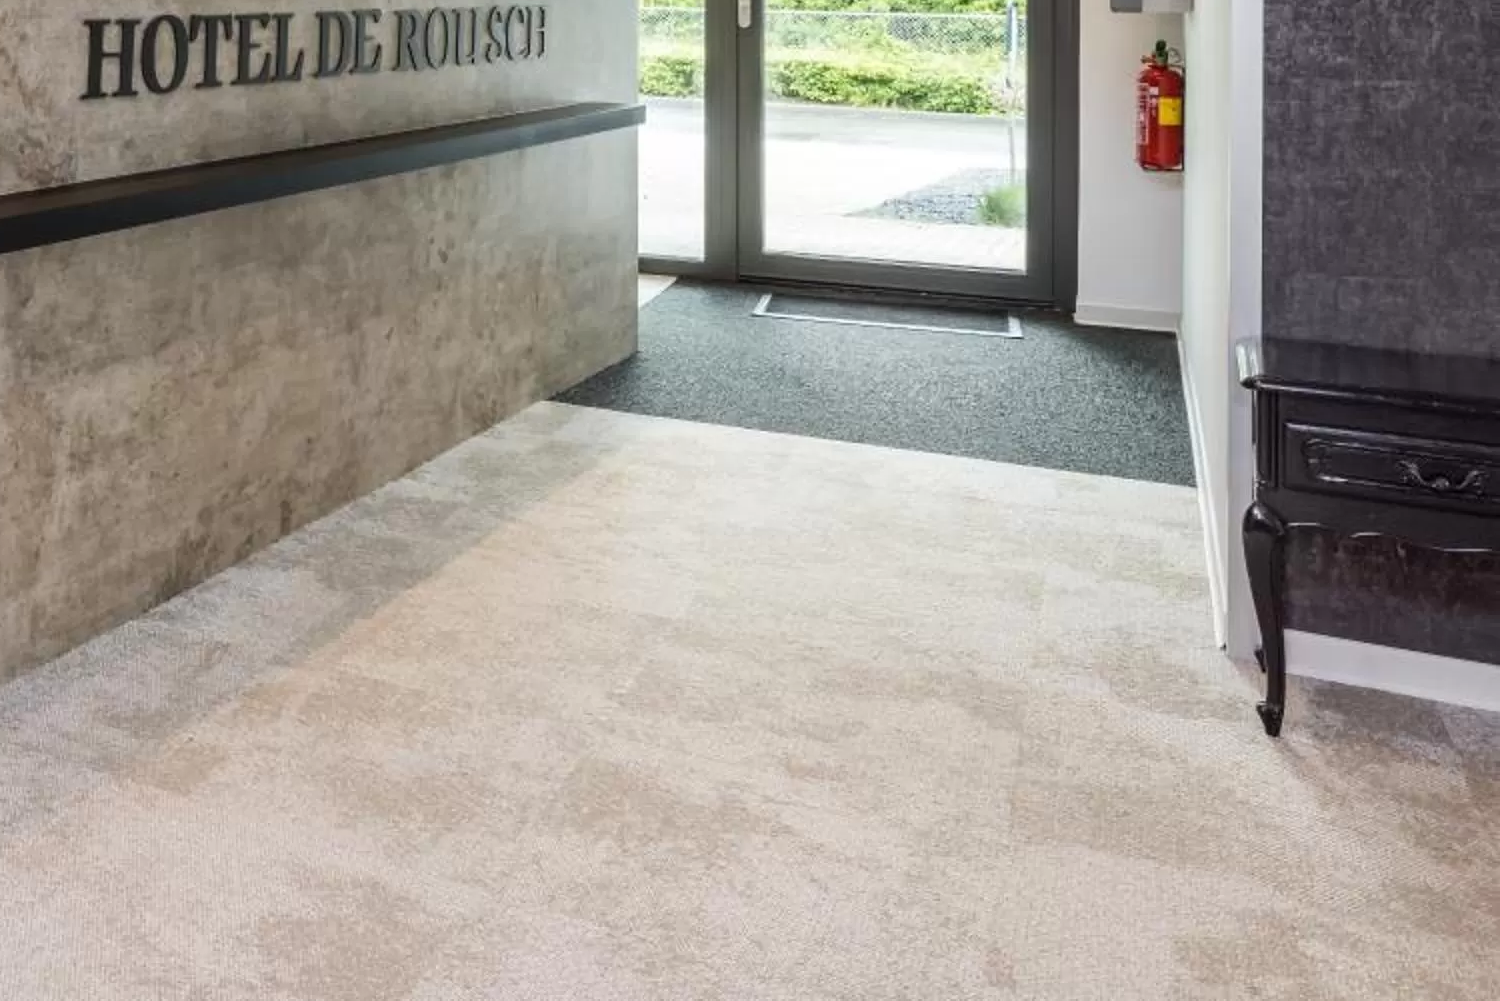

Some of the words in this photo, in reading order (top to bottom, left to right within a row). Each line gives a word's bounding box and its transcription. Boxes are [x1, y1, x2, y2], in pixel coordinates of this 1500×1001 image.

[79, 13, 304, 100] HOTEL
[312, 8, 382, 79] DE
[391, 4, 550, 72] ROUSCH
